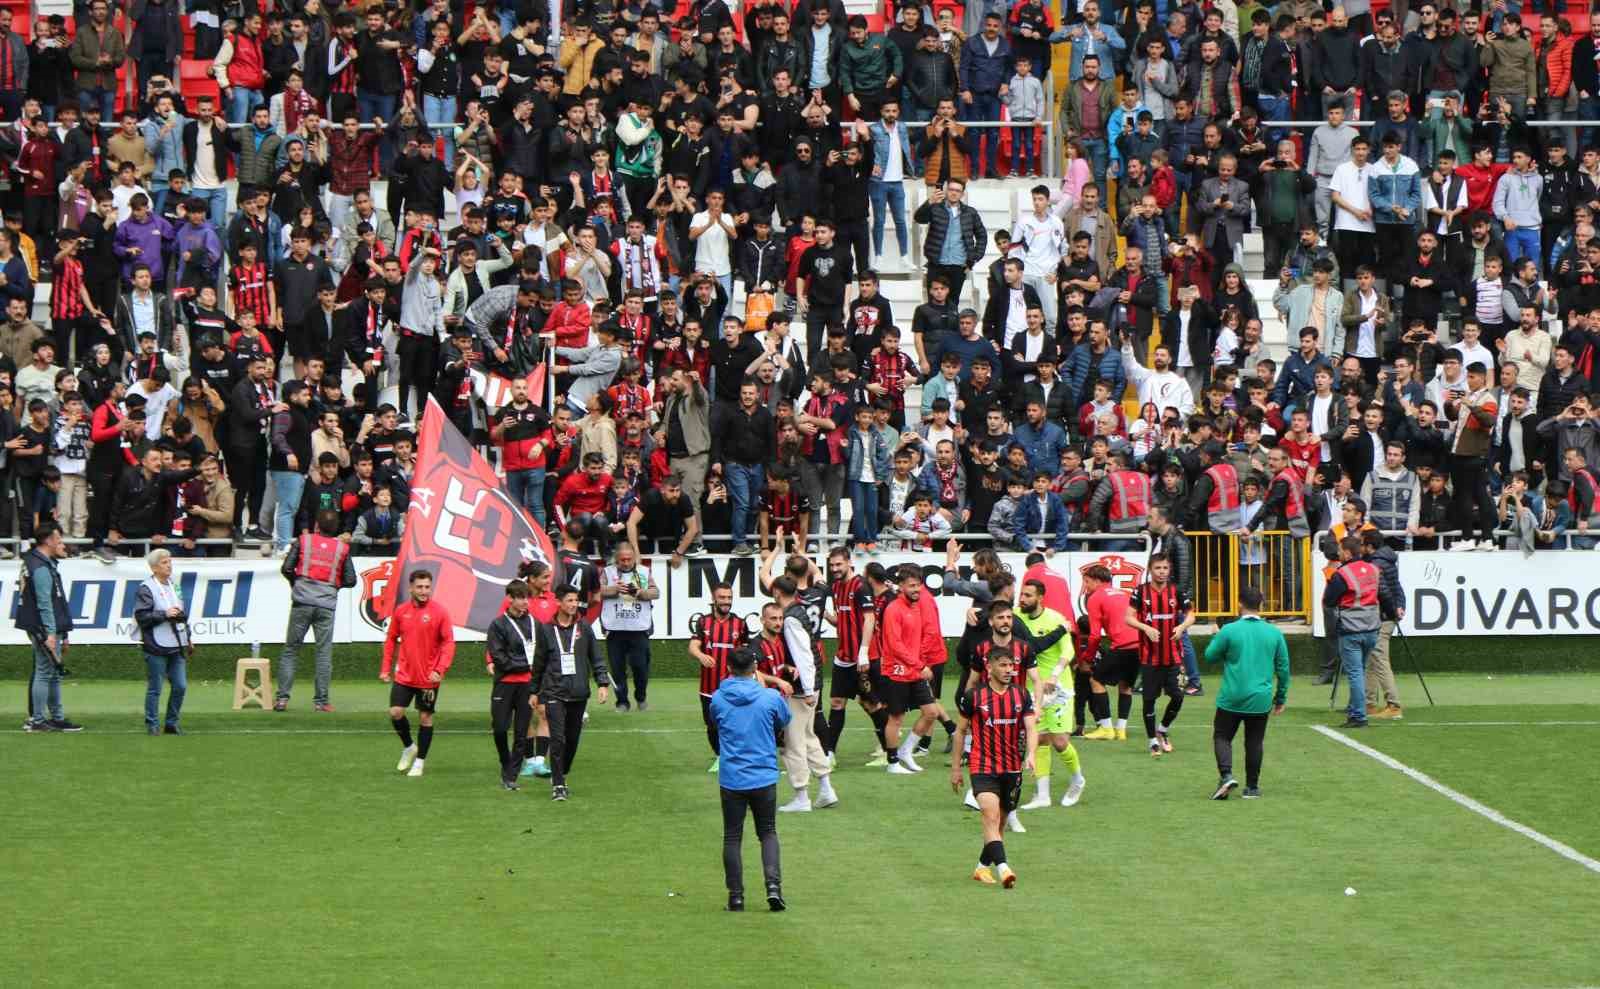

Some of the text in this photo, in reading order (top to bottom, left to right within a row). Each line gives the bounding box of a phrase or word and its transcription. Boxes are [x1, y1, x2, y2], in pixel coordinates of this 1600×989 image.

[409, 487, 436, 518] 24
[1104, 558, 1121, 570] 24
[1424, 559, 1442, 585] By
